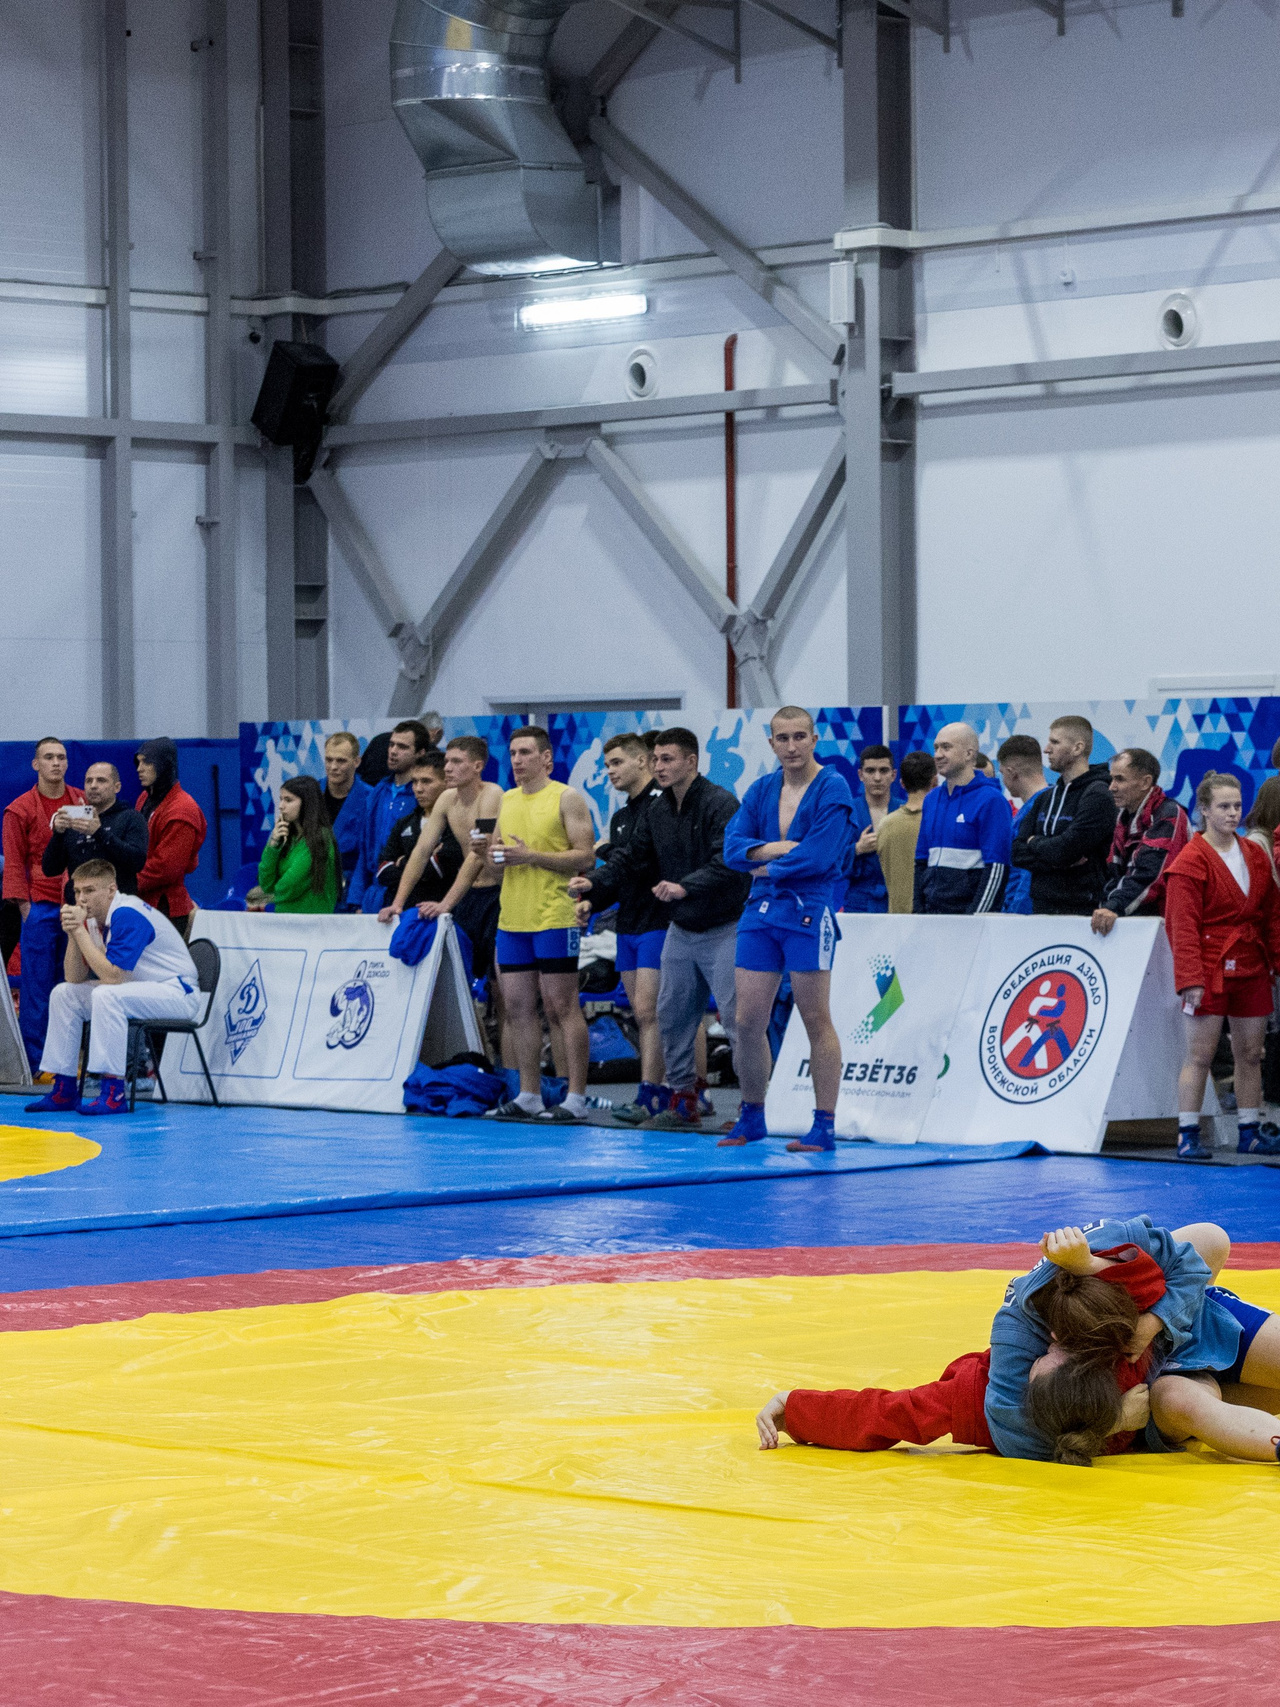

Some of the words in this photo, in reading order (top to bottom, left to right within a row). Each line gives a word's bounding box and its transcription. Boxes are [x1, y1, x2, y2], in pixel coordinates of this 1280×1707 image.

[1002, 954, 1072, 1000] ФЕДЕРАЦИЯ
[1076, 962, 1102, 1006] ДЗЮДО
[797, 1058, 919, 1085] ПЕЗЁТ36
[987, 1025, 1039, 1096] ВОРОНЕЖСКОЙ
[1048, 1028, 1096, 1089] ОБЛАСТИ
